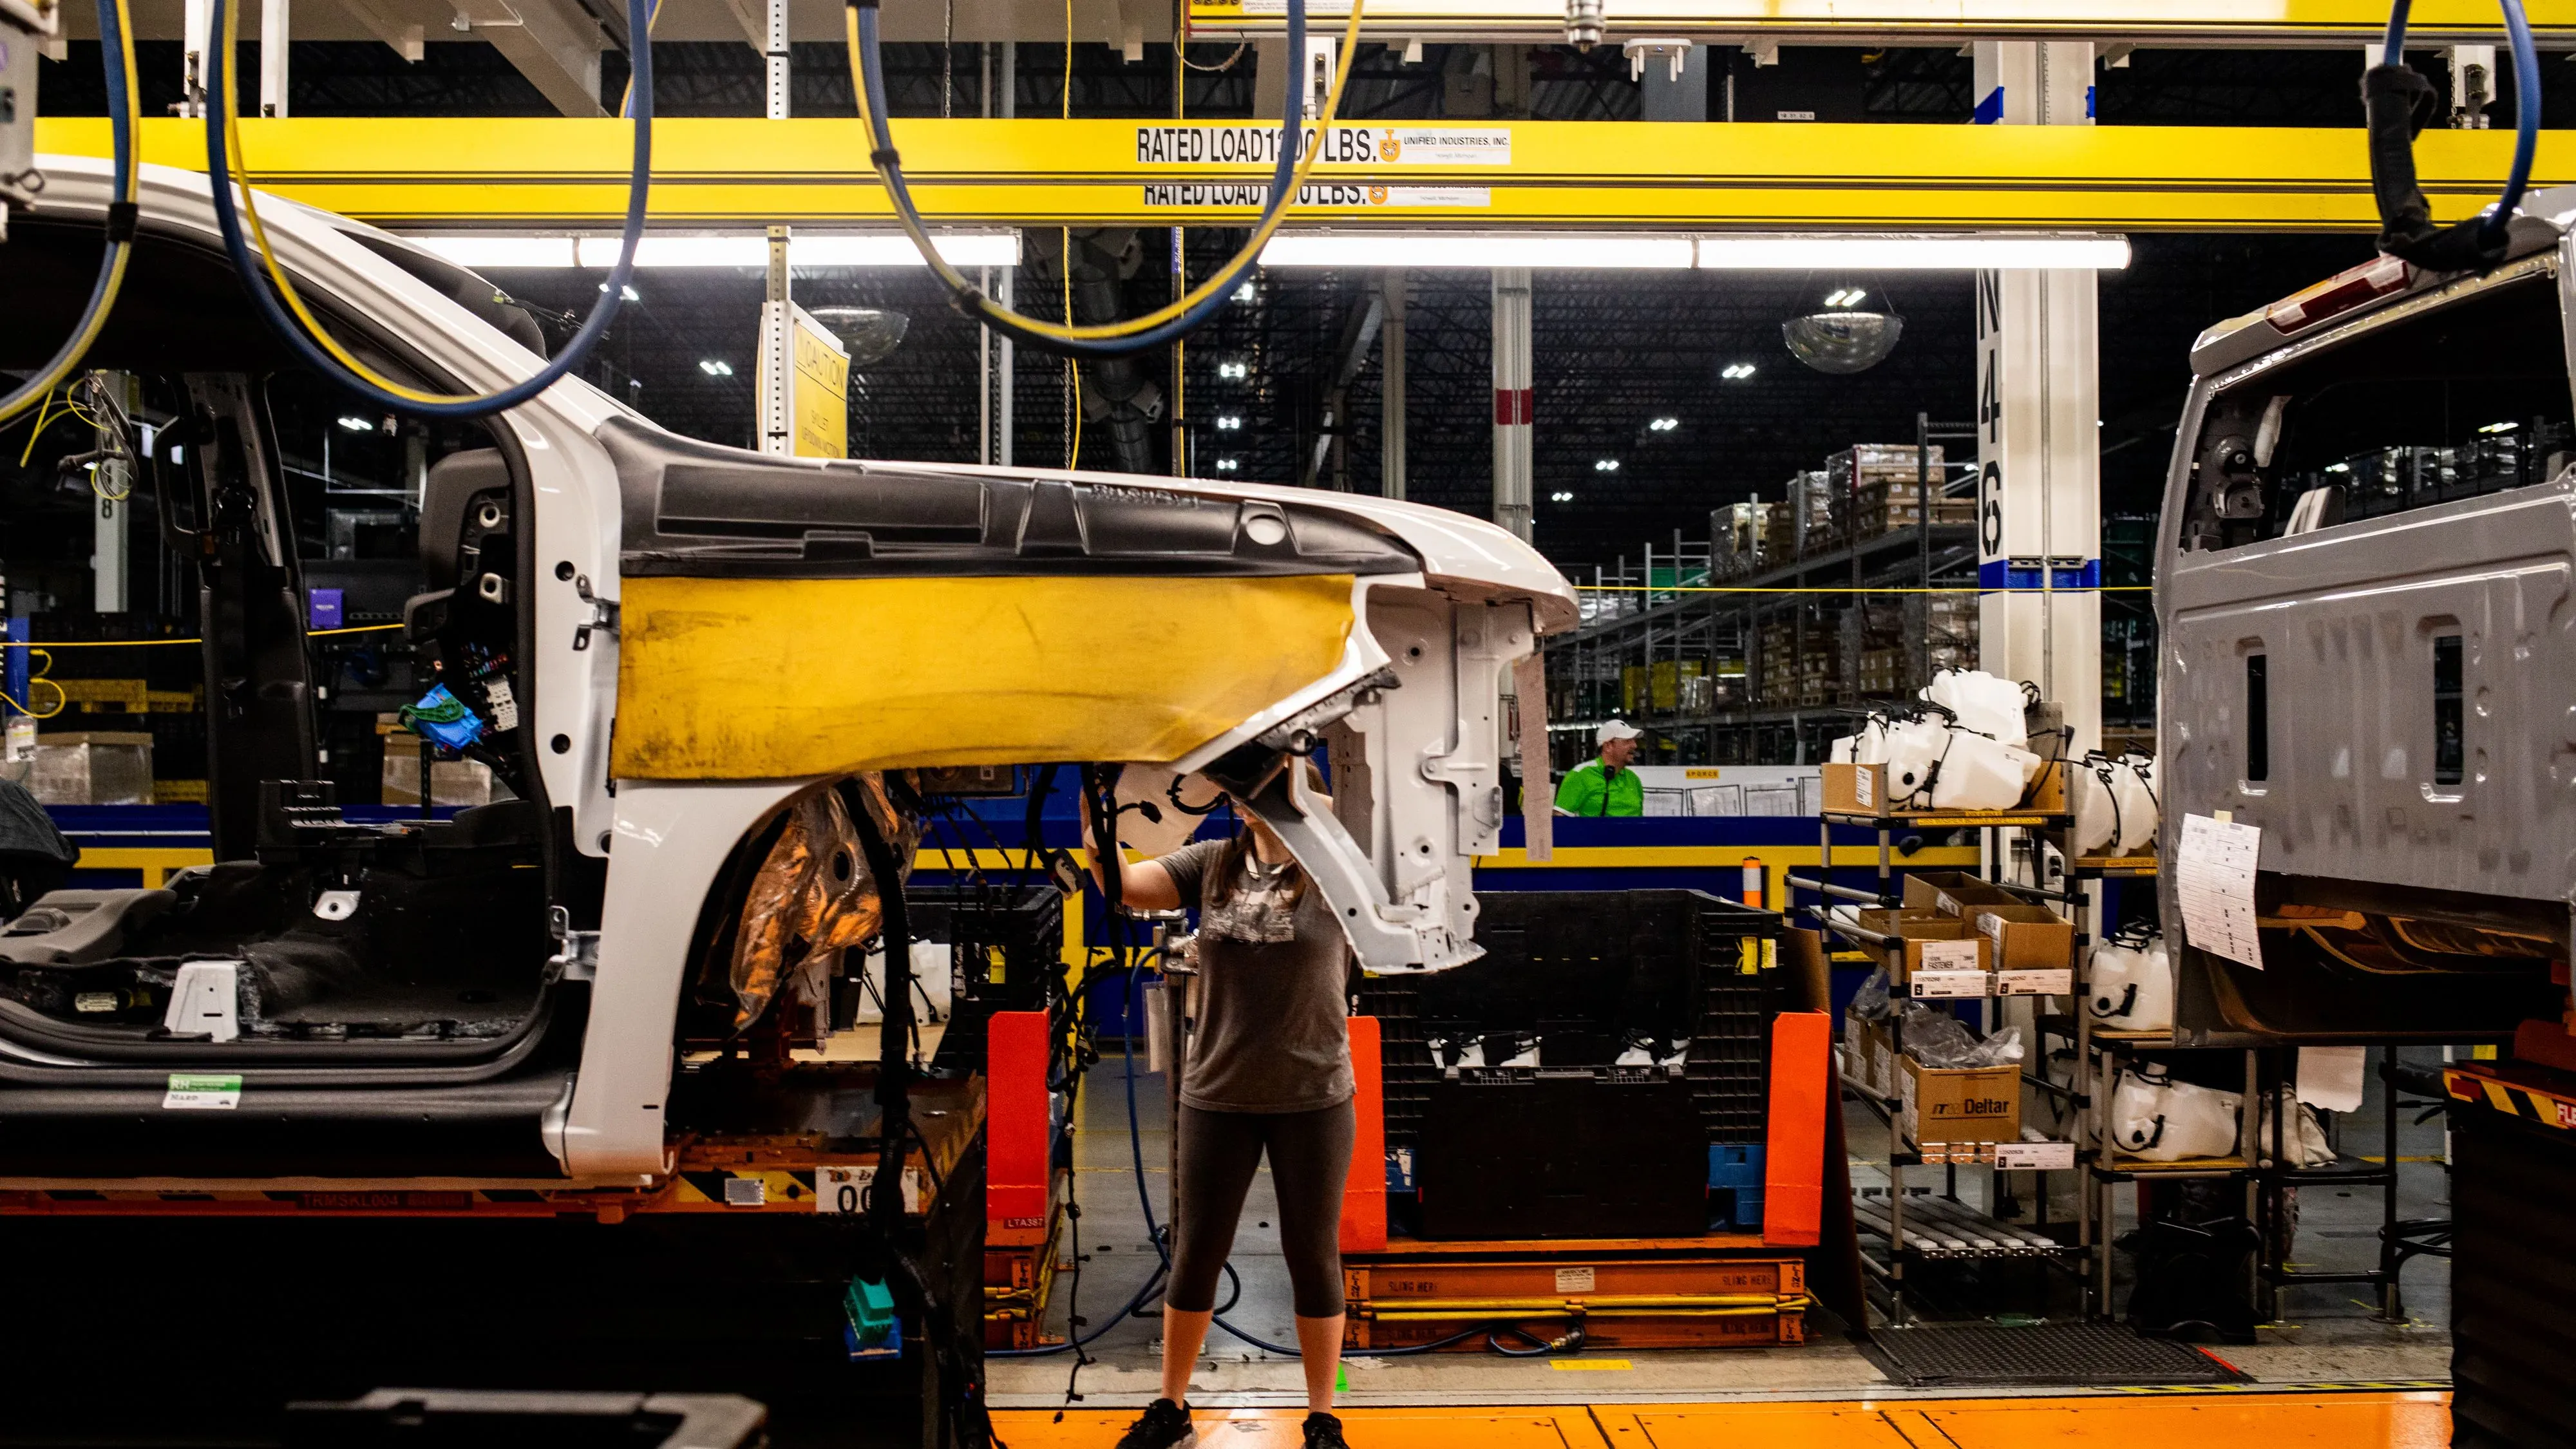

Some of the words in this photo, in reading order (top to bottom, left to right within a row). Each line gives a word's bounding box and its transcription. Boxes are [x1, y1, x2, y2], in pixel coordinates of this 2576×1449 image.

[1138, 128, 1202, 162] RATED
[1211, 128, 1263, 162] LOAD
[1324, 128, 1376, 162] LBS.
[1404, 136, 1437, 145] UNIFIED
[1439, 136, 1491, 146] INDUSTRIES,
[1493, 136, 1510, 146] INC.
[1144, 185, 1205, 205] RATED
[1213, 185, 1260, 205] LOAD
[1318, 185, 1366, 205] LBS.
[806, 340, 844, 390] CAUTION
[1964, 1098, 2009, 1114] Deltar
[1388, 1281, 1414, 1293] SLING
[1417, 1281, 1437, 1293] HER
[1722, 1274, 1748, 1287] SLING
